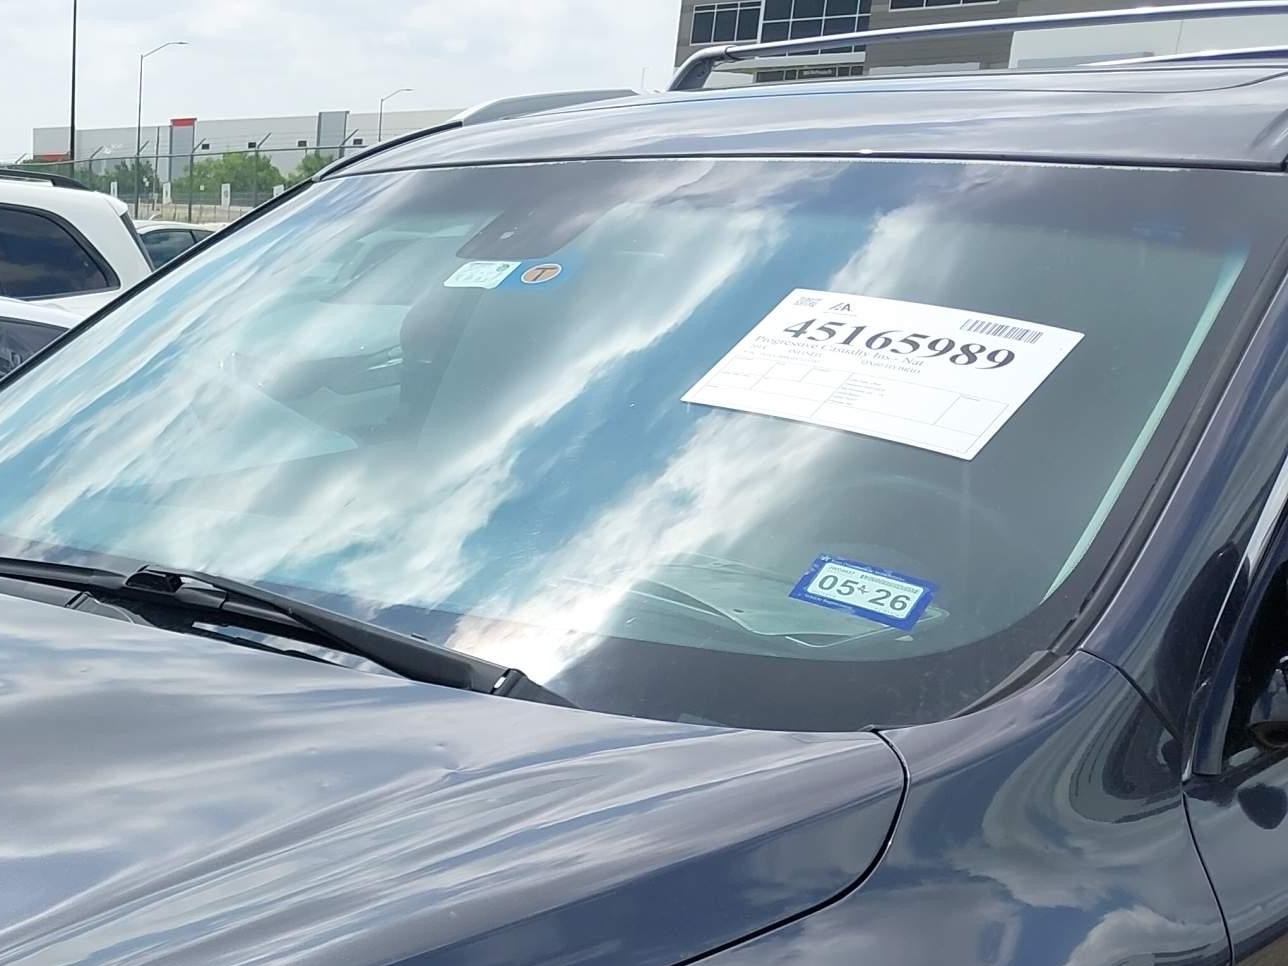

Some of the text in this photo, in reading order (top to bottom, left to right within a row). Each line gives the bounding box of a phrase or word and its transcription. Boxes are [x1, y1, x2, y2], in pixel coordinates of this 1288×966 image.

[783, 318, 1016, 370] 45165989
[818, 574, 858, 596] 05
[868, 588, 911, 611] 26
